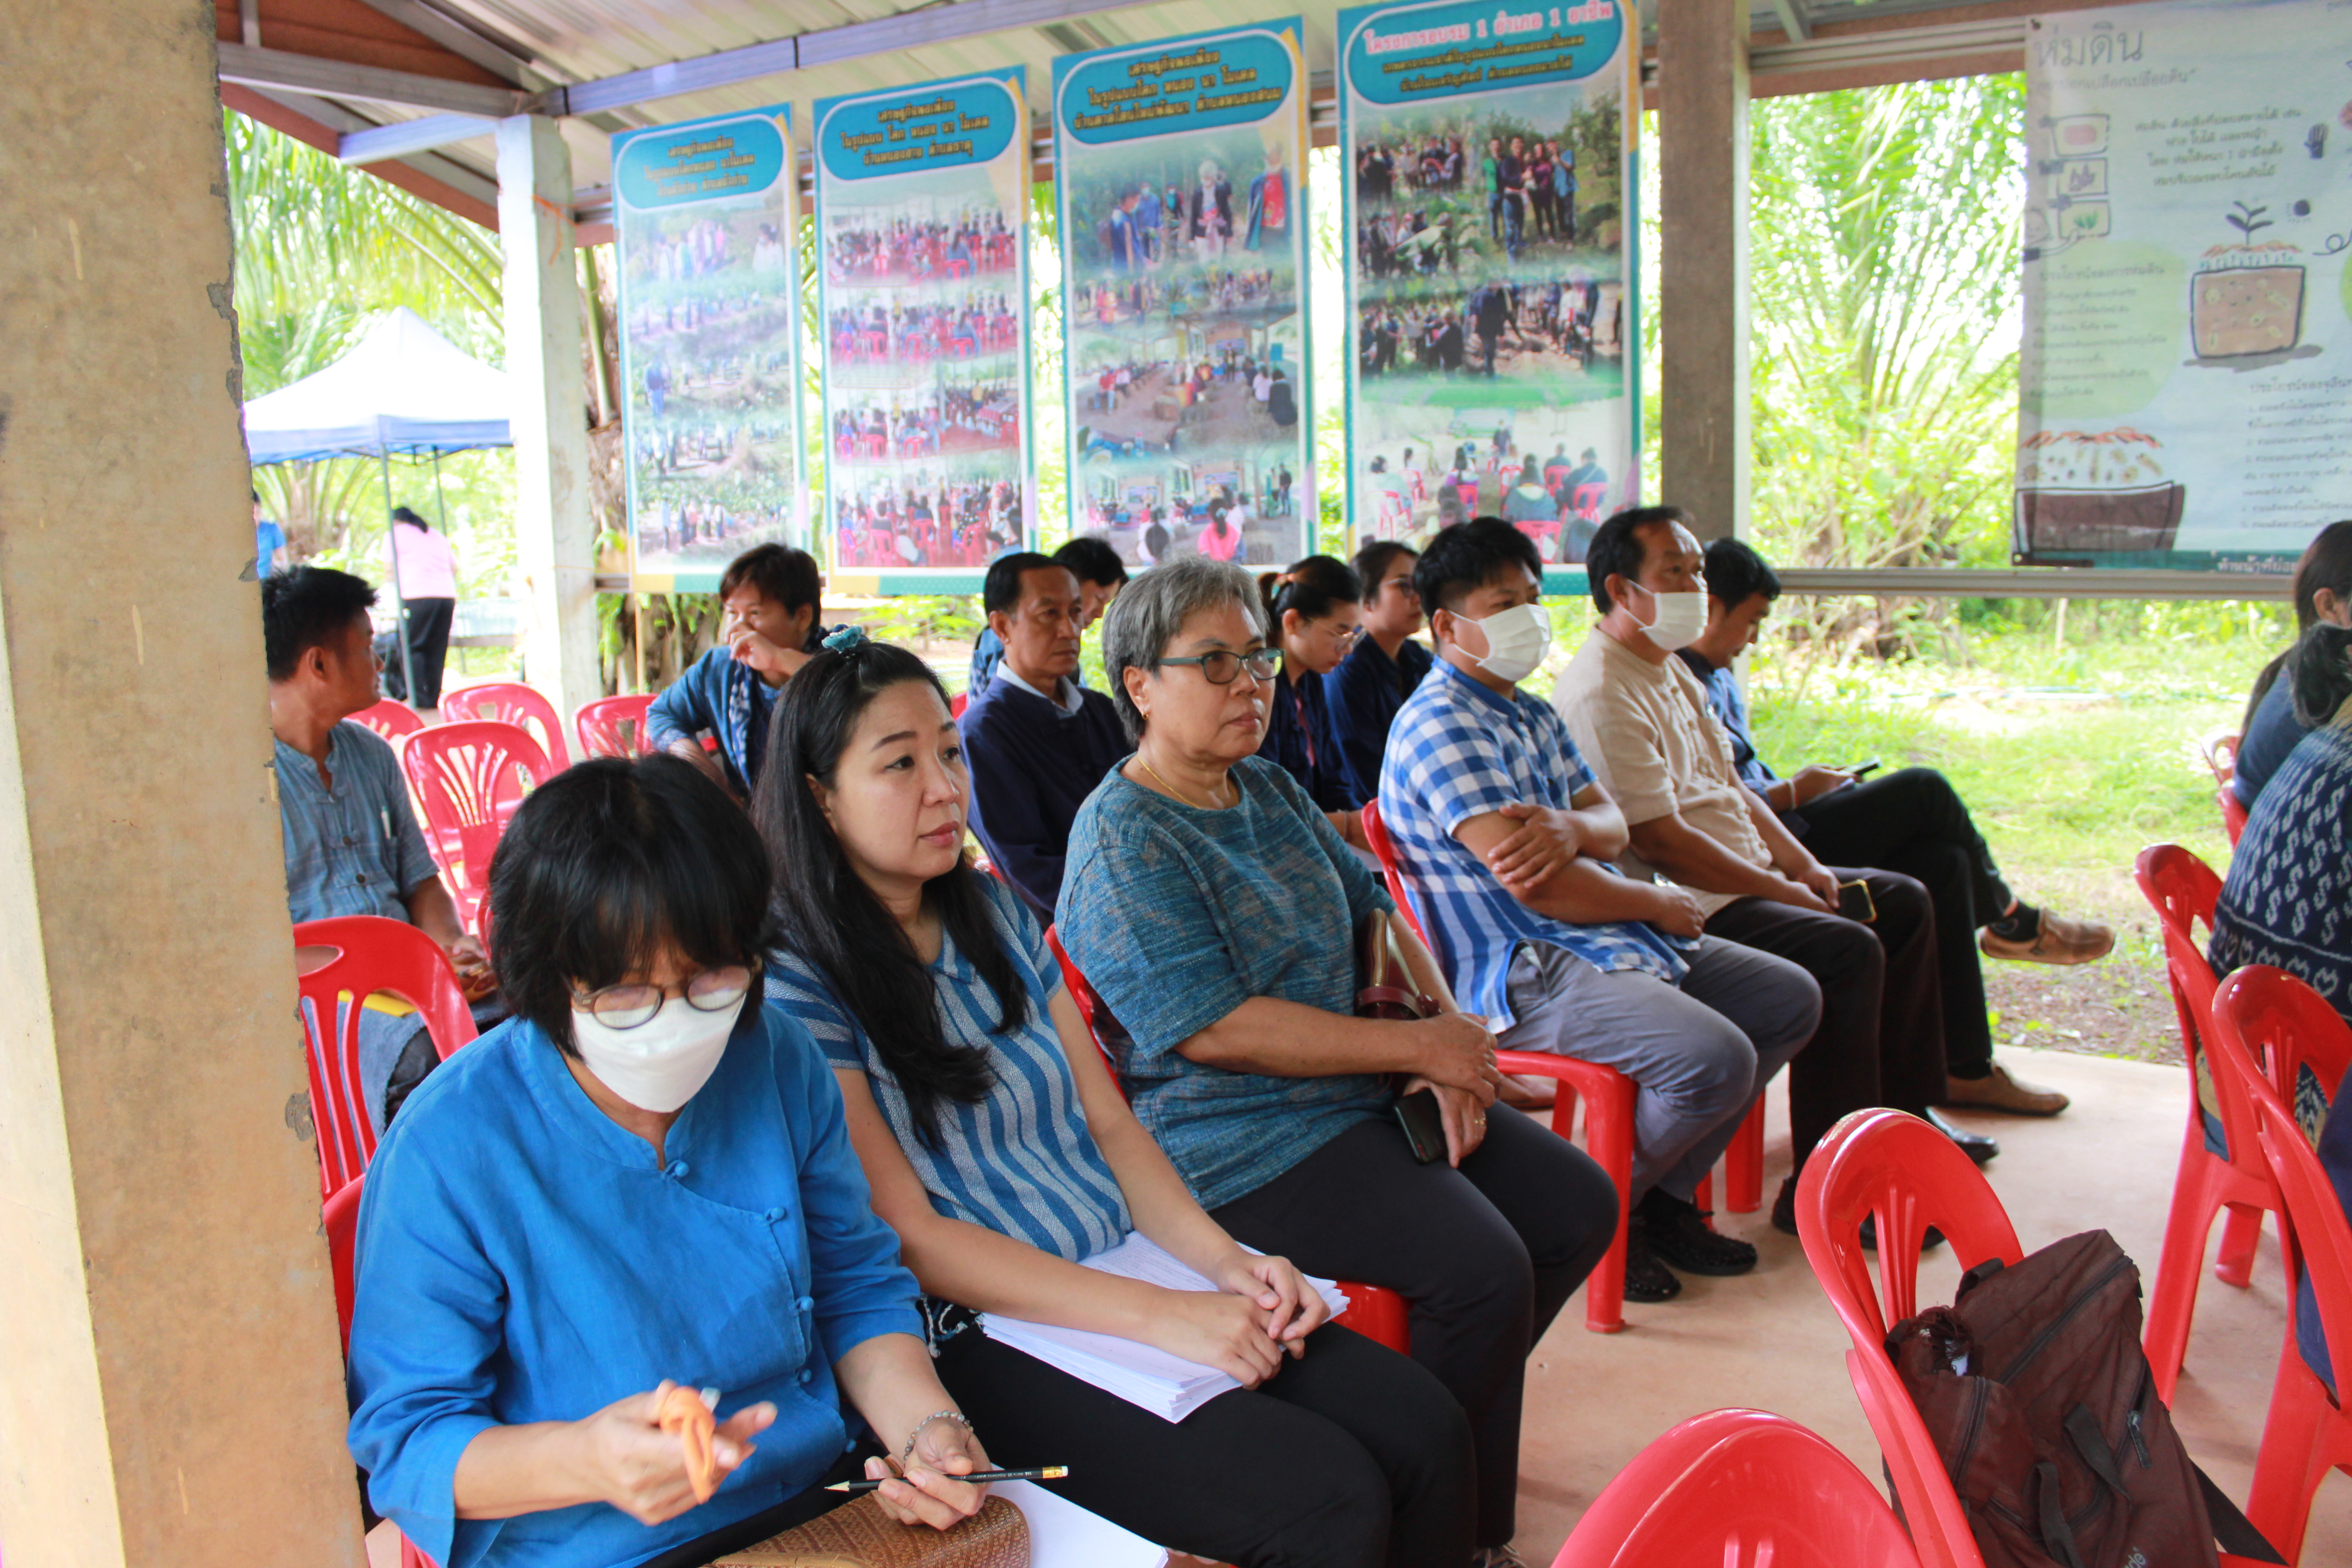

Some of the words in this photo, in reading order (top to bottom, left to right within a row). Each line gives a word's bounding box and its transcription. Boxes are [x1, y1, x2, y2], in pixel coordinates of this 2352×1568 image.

[1494, 10, 1542, 34] อำเภอ
[2034, 21, 2144, 68] ห่มดิน
[1128, 47, 1220, 77] เศรษฐกิจพอเพียง
[877, 96, 955, 123] เศรษฐกิจพอเพียง
